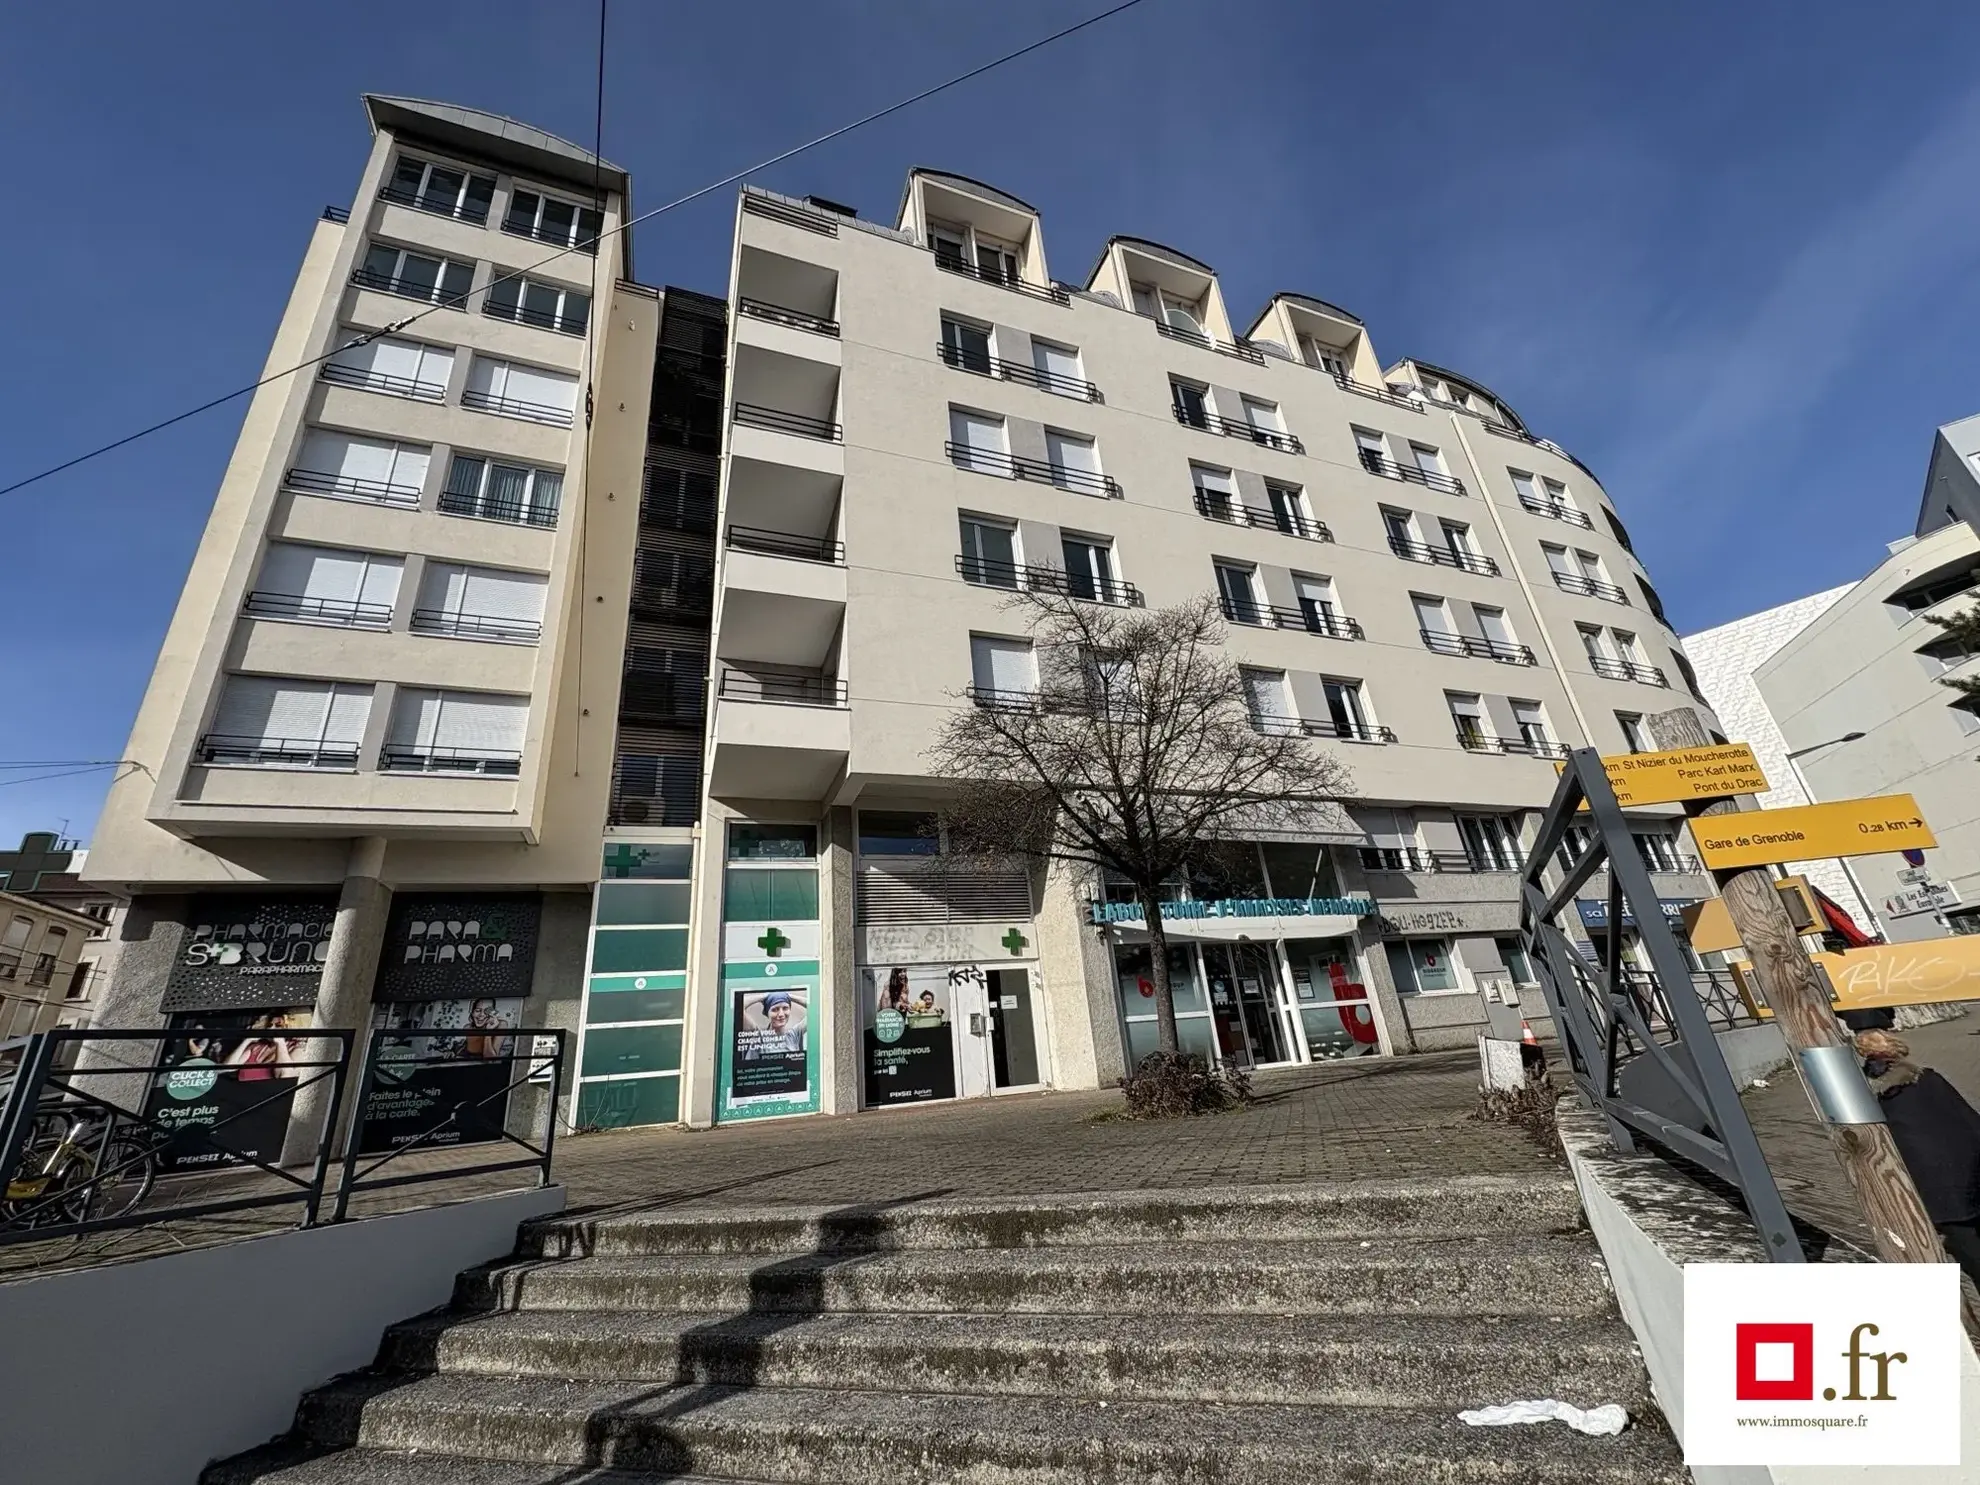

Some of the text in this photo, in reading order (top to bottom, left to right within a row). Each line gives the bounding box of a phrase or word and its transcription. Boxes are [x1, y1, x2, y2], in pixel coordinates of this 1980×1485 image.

[1623, 759, 1635, 770] St
[1636, 755, 1667, 769] Nizier
[1669, 754, 1683, 766] du
[1684, 748, 1749, 765] Moucherotte
[1678, 768, 1703, 780] Parc
[1705, 764, 1726, 777] Karl
[1728, 762, 1756, 775] Marx
[1693, 781, 1720, 794] Pont
[1722, 779, 1736, 791] du
[1737, 777, 1763, 789] Drac
[1704, 818, 1908, 851] Gare de Grenoble 0.28 km
[408, 920, 480, 940] PARA
[403, 943, 514, 964] PHARMA
[169, 1078, 215, 1089] COLLECT
[171, 1069, 204, 1081] CLICK
[157, 1104, 219, 1119] C'est plus
